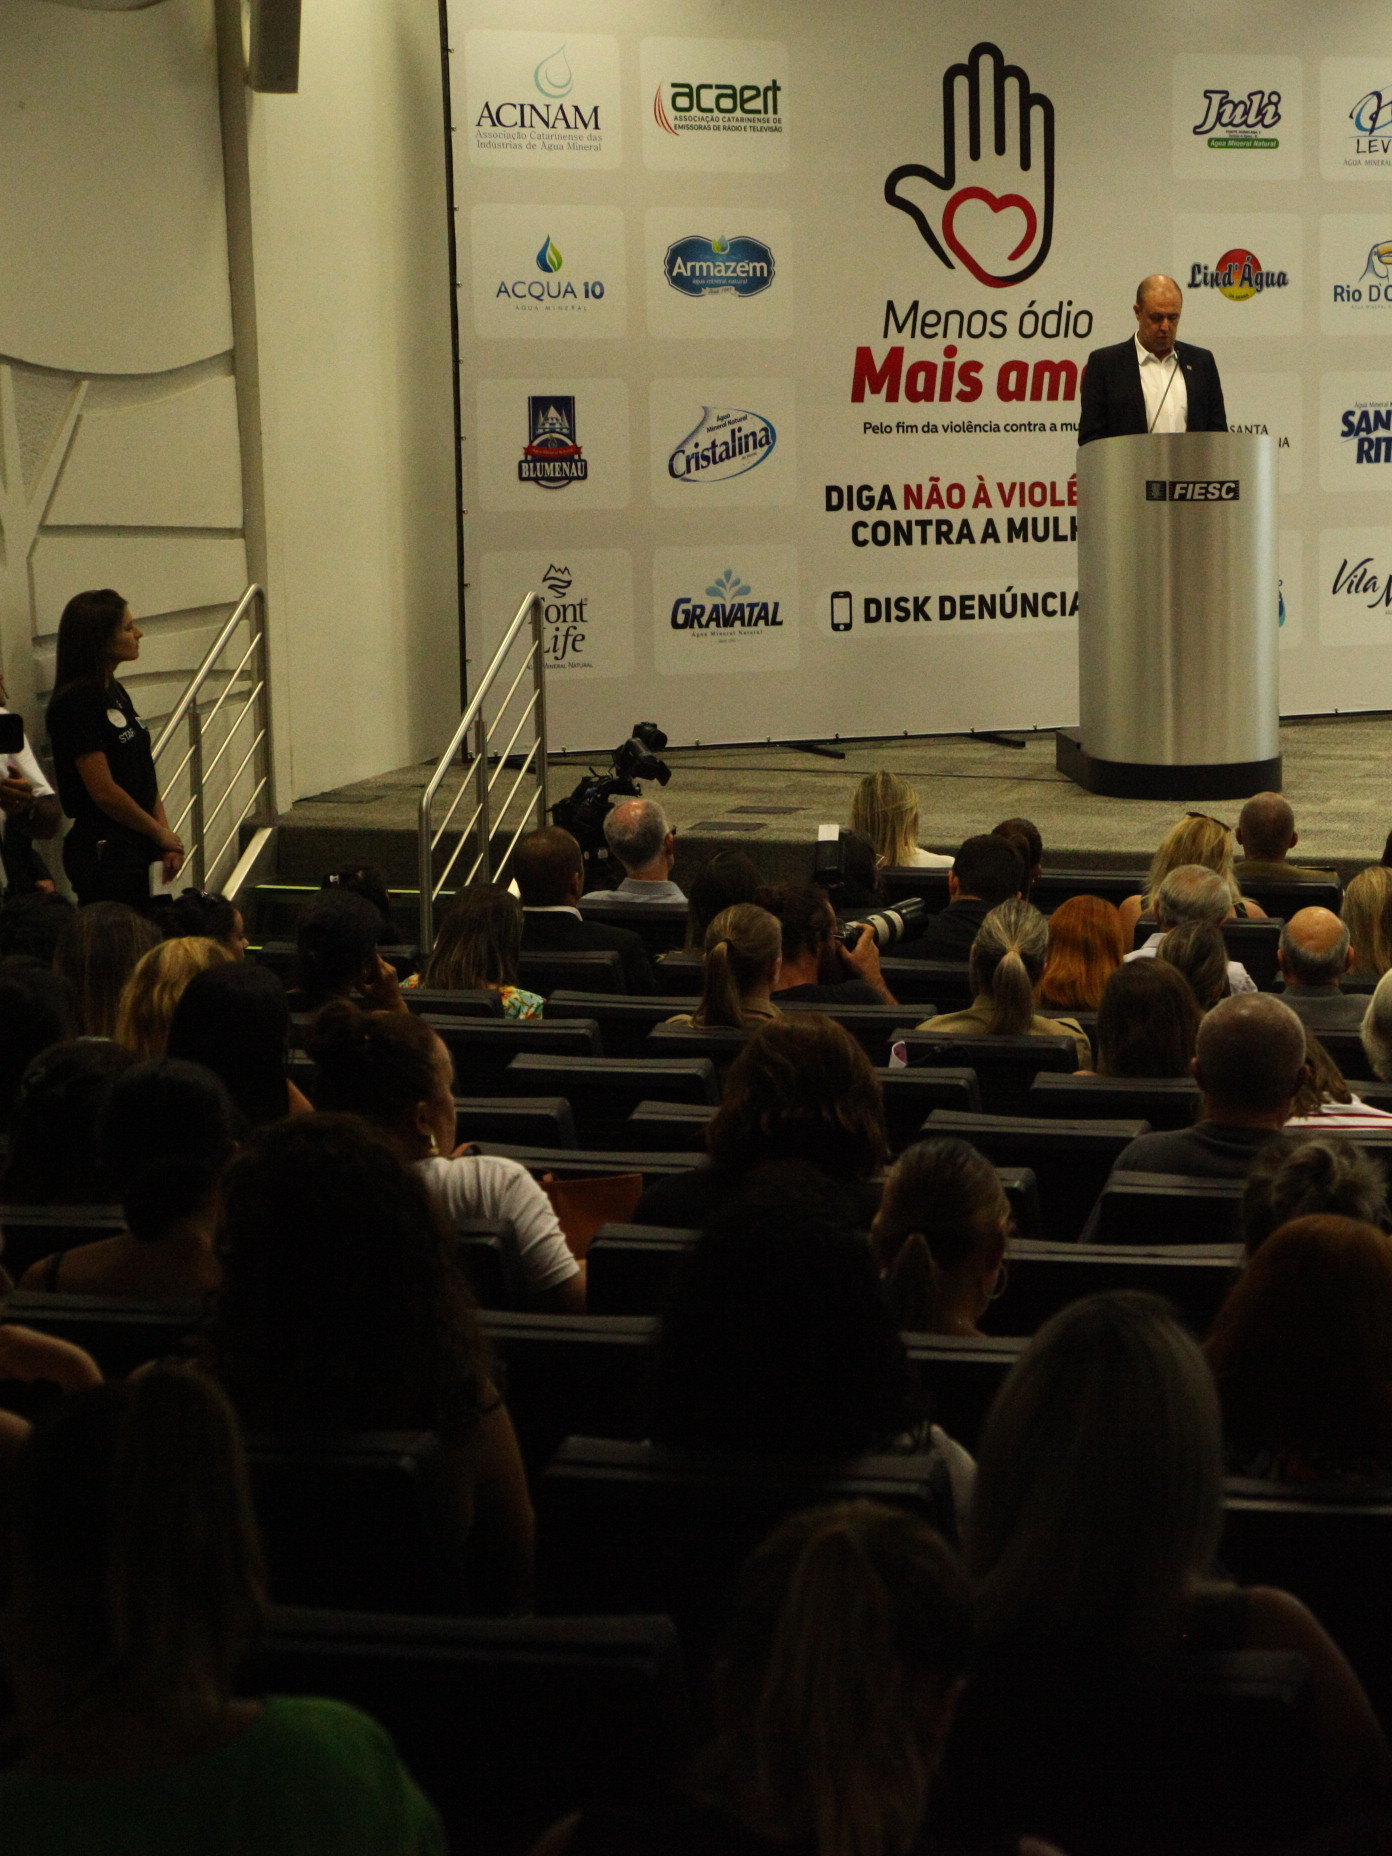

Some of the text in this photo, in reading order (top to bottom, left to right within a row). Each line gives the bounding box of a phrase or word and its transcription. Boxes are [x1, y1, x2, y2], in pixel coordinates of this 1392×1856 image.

[670, 79, 781, 115] acaert
[475, 101, 601, 130] ACINAM
[673, 115, 720, 124] ASSOCIAÇÃO
[721, 116, 770, 124] CATARINENSE
[1193, 89, 1281, 135] Juli
[475, 130, 602, 142] Associação Catarinense das
[722, 124, 742, 132] RÁDIO
[476, 140, 602, 151] Indústrias de Água Mineral
[672, 256, 768, 277] Armazém
[496, 281, 605, 301] ACQUA 10
[1333, 285, 1363, 302] Rio
[883, 299, 1093, 339] Menos ódio
[850, 344, 1088, 403] Mais am
[706, 414, 748, 433] Mineral Natural
[863, 421, 892, 434] Pelo
[896, 421, 918, 434] fim
[921, 421, 939, 434] da
[941, 419, 1001, 433] violência
[1003, 421, 1046, 433] contra
[1049, 422, 1058, 432] a
[1229, 424, 1268, 435] SANTA
[668, 426, 772, 478] Cristalina
[521, 461, 585, 478] BLUMENAU
[825, 484, 897, 512] DIGA
[903, 476, 966, 510] NÃO
[971, 475, 993, 509] À
[1173, 482, 1236, 500] FIESC
[851, 518, 976, 547] CONTRA
[980, 518, 1001, 544] A
[1332, 558, 1380, 595] Vila
[541, 597, 588, 624] ont
[670, 597, 783, 629] GRAVATAL
[864, 596, 932, 623] DISK
